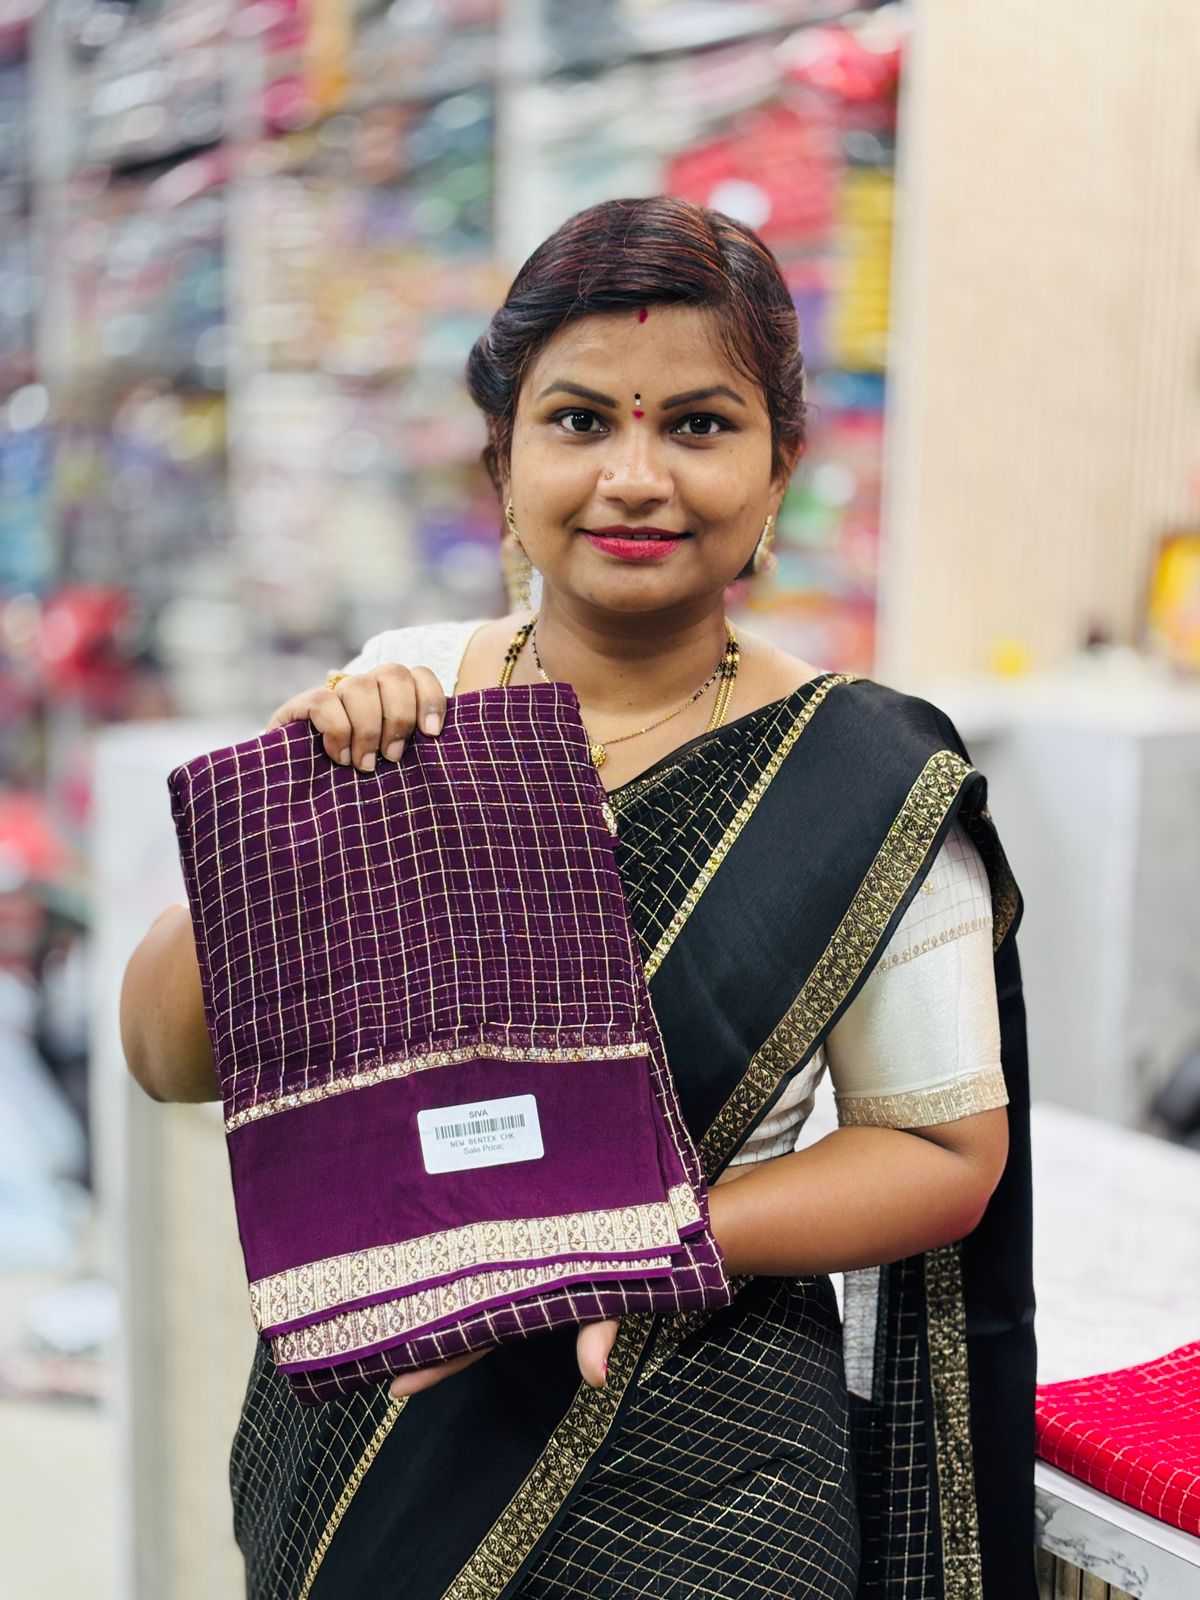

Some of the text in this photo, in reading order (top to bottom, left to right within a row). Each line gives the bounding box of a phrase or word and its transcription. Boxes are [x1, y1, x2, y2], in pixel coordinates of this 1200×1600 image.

[469, 1109, 488, 1119] SIVA
[450, 1132, 515, 1148] NEW BENTEX CHK
[463, 1146, 481, 1155] Sale
